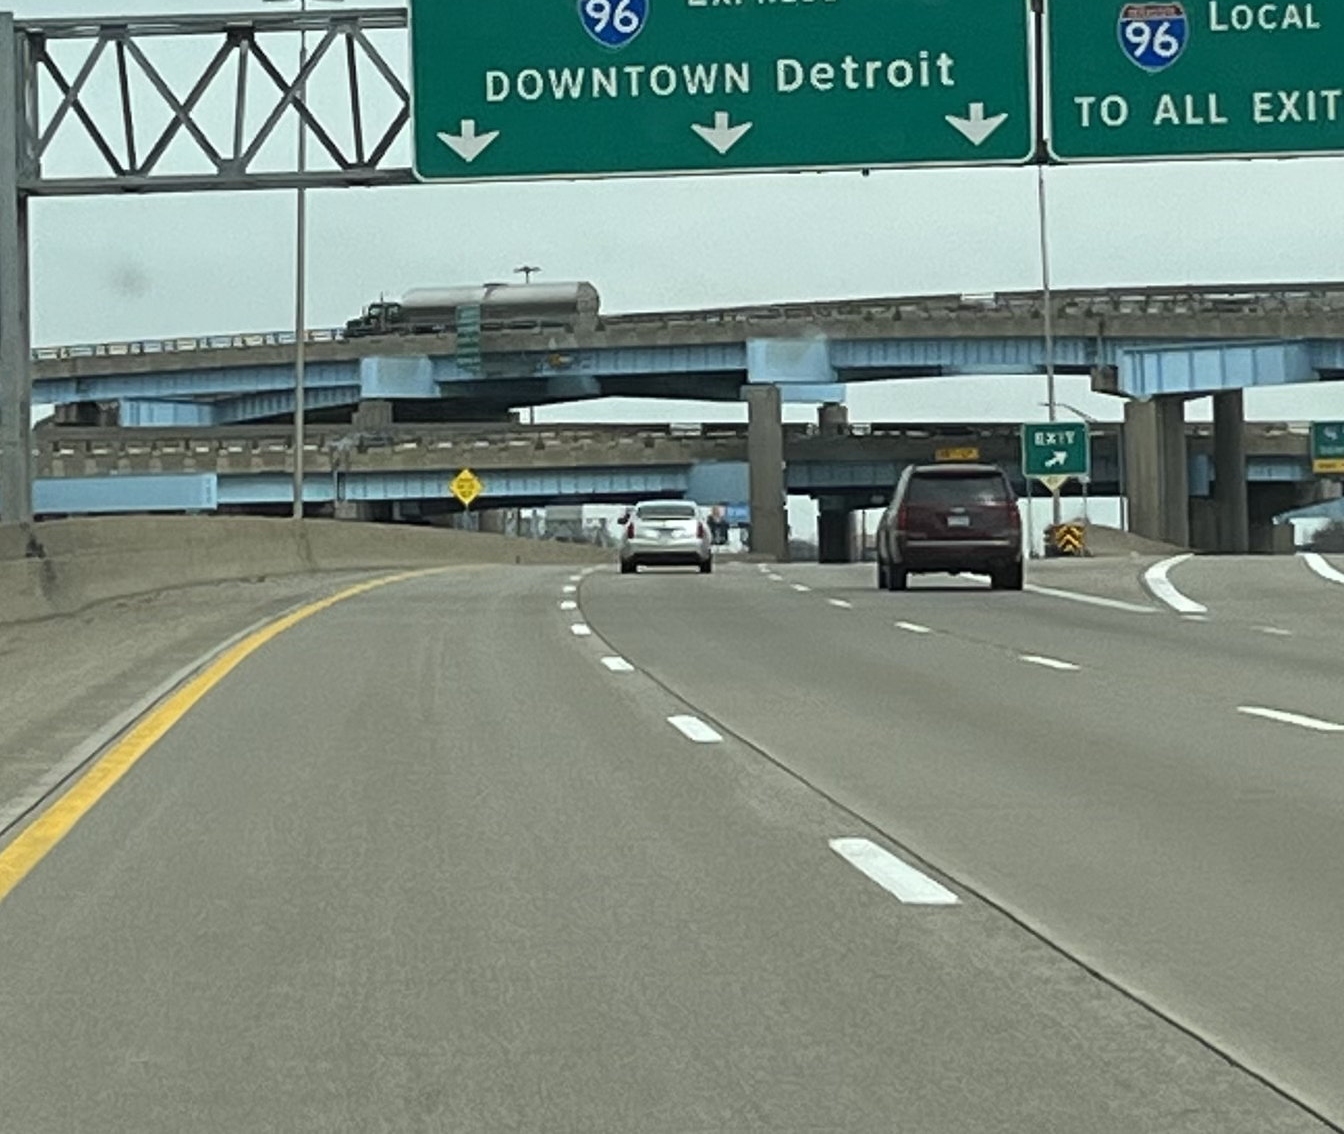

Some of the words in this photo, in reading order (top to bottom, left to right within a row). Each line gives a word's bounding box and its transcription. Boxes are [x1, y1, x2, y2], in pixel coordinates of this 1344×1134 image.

[1125, 21, 1179, 58] 96
[485, 62, 750, 102] DOWNTOWN
[776, 50, 955, 92] Detroit
[1074, 94, 1129, 127] TO
[1153, 92, 1229, 125] ALL
